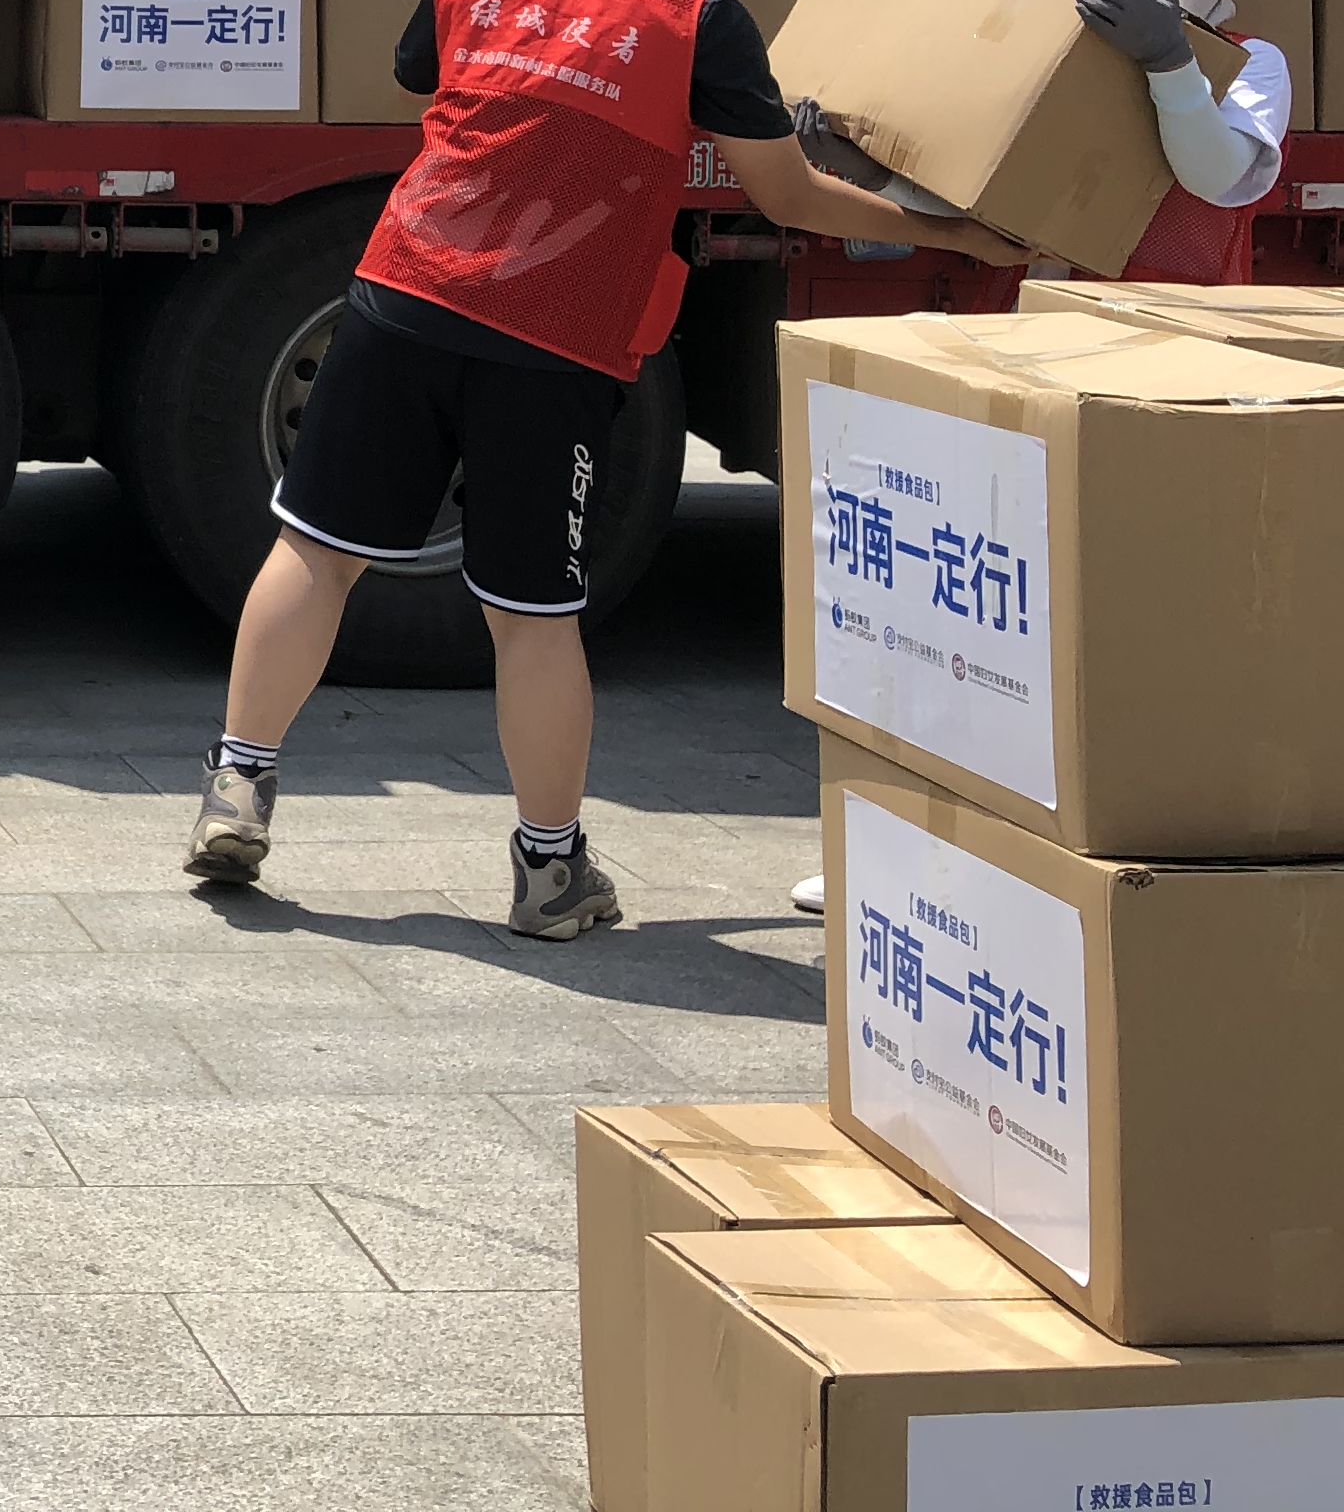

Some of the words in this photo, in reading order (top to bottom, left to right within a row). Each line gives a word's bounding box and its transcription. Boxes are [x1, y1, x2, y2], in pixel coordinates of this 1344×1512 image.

[98, 3, 285, 45] 河南一定行!
[878, 464, 940, 506] 【救援食品包】
[826, 485, 1028, 635] 河南一定行!
[909, 891, 979, 951] 【救援食品包】
[858, 899, 1067, 1105] 河南一定行!
[1075, 1478, 1213, 1511] 【救援食品包】
